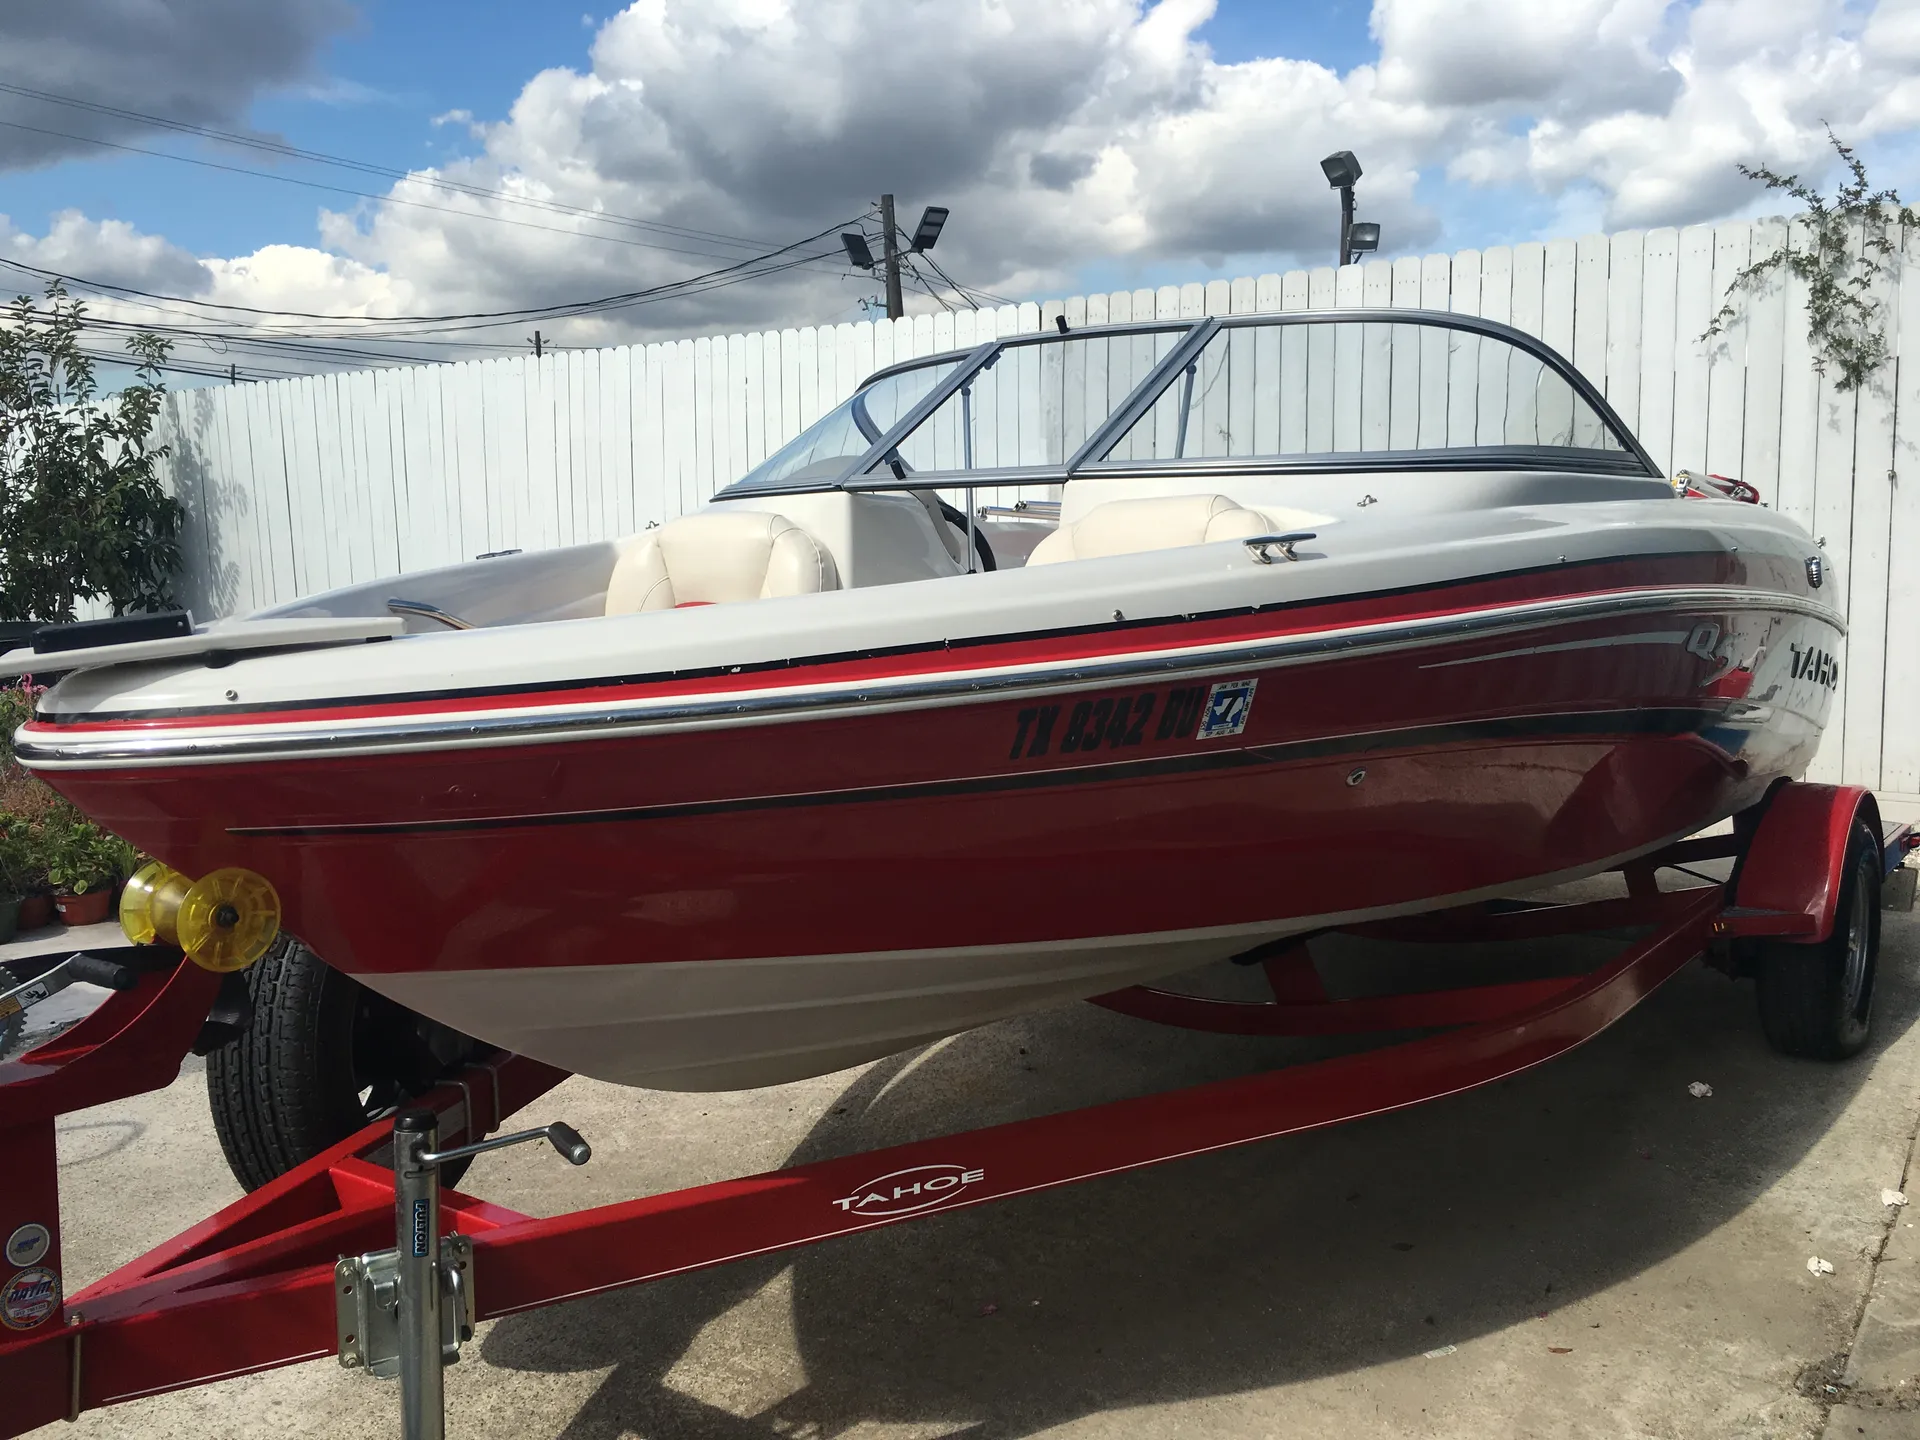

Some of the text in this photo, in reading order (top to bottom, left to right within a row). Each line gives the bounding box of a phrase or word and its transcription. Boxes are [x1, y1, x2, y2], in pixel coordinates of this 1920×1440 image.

[1009, 704, 1061, 760] TX
[1060, 692, 1157, 754] 8342
[832, 1168, 984, 1211] TAHOE
[414, 1203, 428, 1254] FULTON
